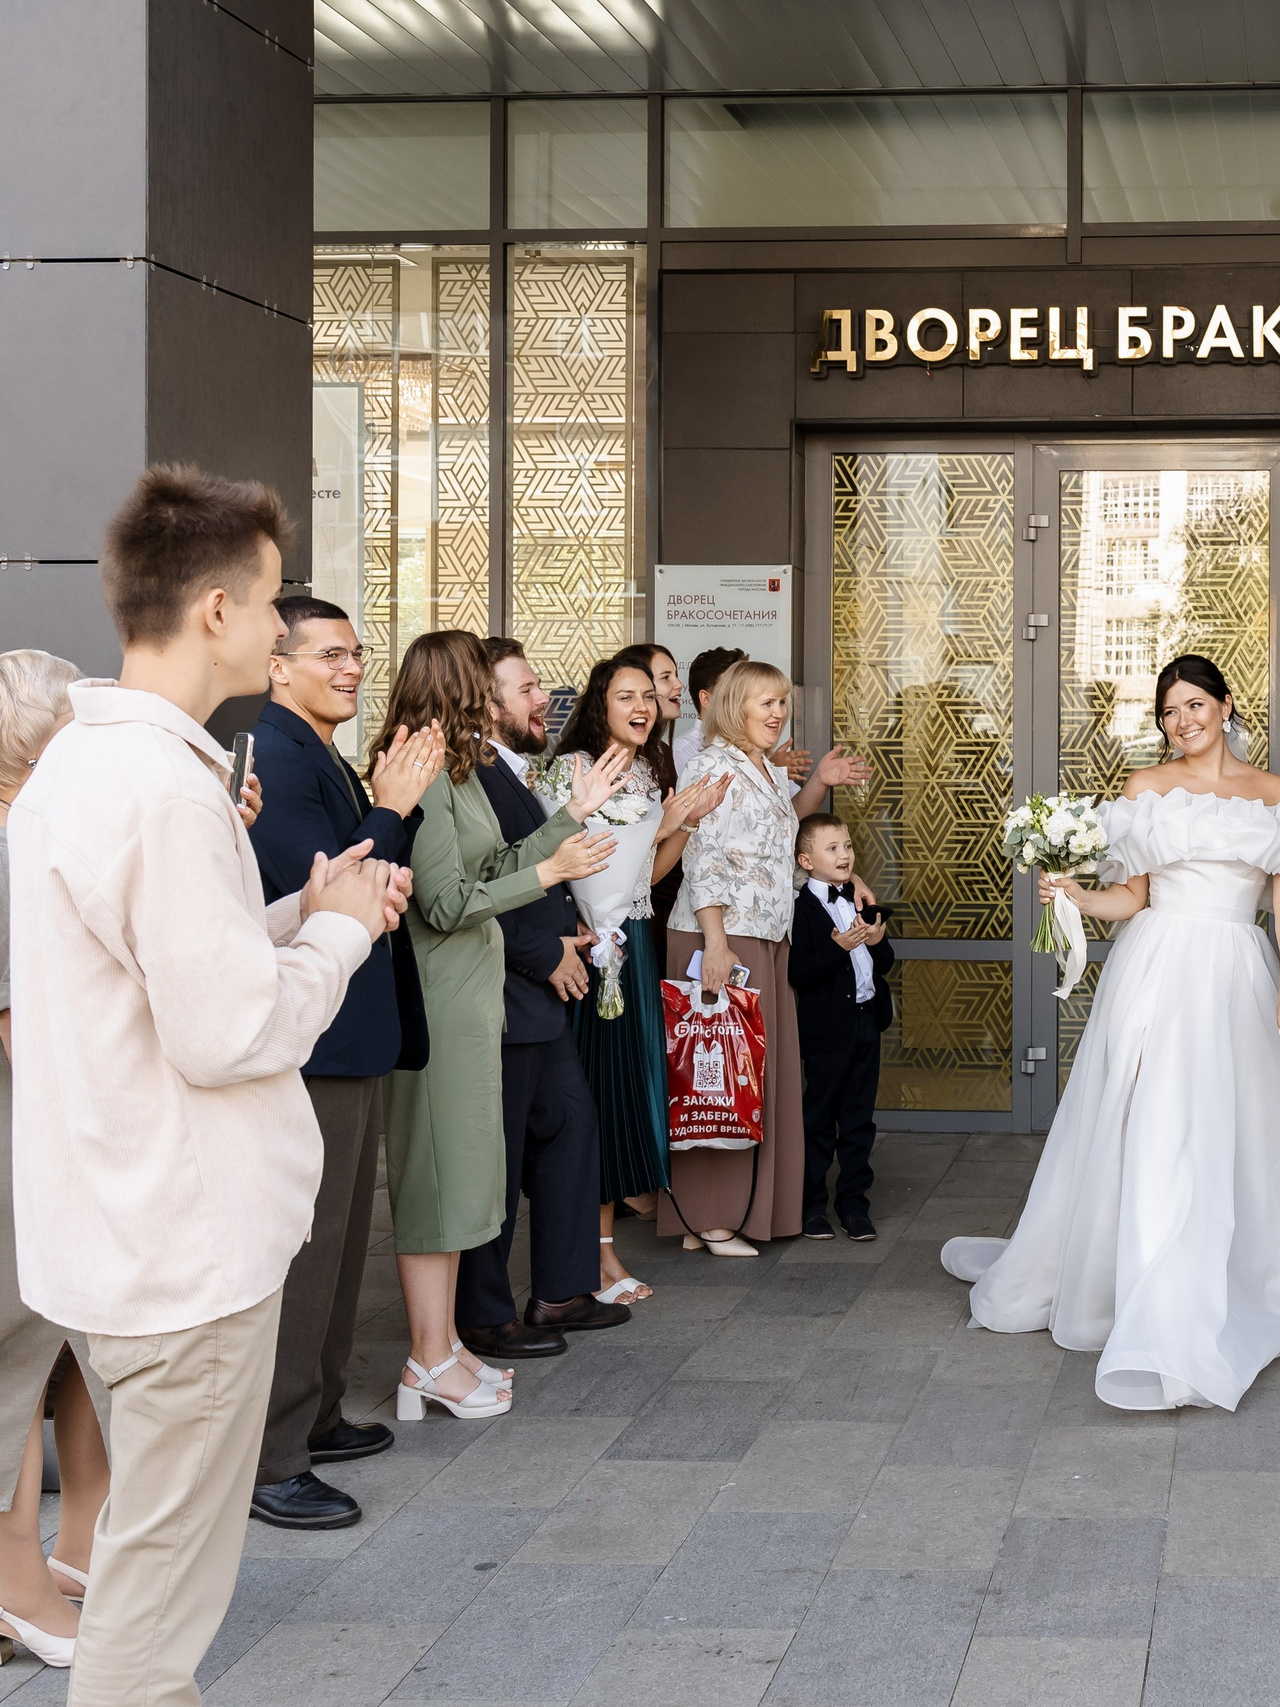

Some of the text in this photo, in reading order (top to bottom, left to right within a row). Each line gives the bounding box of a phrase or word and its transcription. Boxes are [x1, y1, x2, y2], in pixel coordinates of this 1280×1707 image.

[811, 307, 1095, 373] ДВОРЕЦ
[667, 594, 716, 606] ДВОРЕЦ
[667, 610, 777, 620] БРАКОСОЧЕТАНИЯ
[682, 1095, 735, 1107] ЗАКАЖИ
[691, 1110, 738, 1122] ЗАБЕРИ
[674, 1124, 718, 1137] УДОБНОЕ
